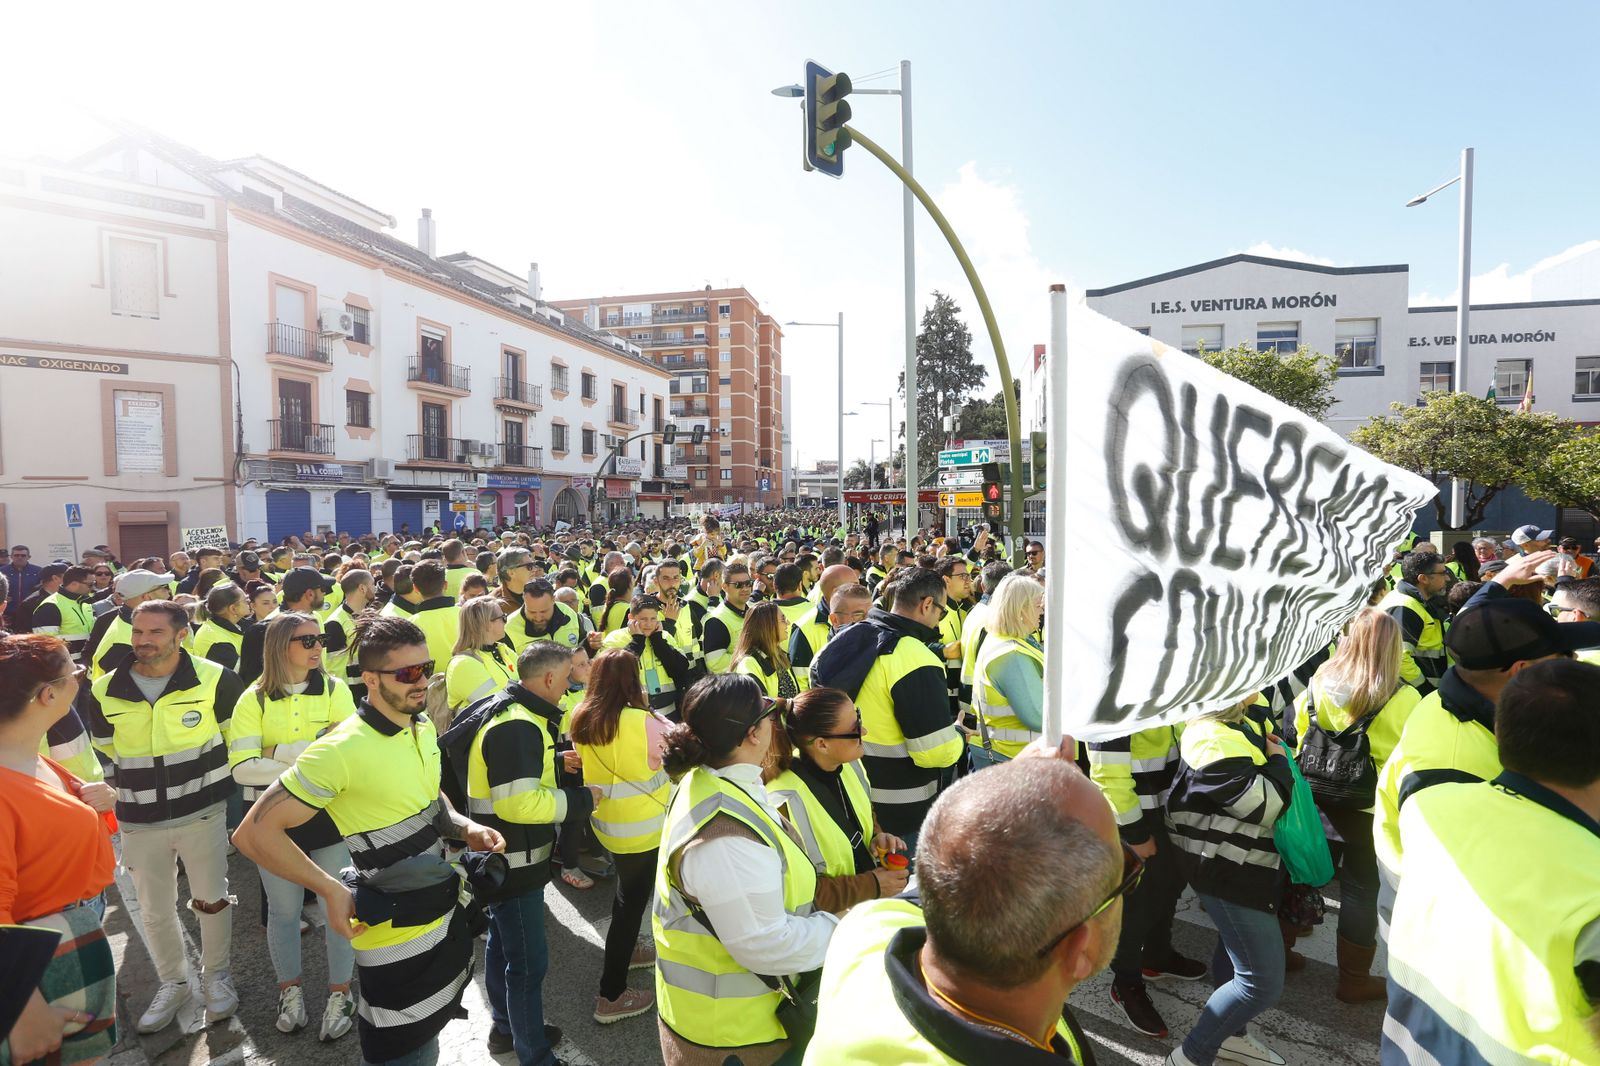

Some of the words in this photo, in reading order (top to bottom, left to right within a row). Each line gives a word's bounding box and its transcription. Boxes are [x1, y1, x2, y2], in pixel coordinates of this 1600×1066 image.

[1151, 301, 1186, 314] I.E.S.
[1191, 297, 1267, 312] VENTURA
[1272, 291, 1337, 309] MORÓN
[1434, 333, 1498, 346] VENURA
[1501, 329, 1556, 344] MORÓN
[39, 358, 121, 373] OXIGENADO
[186, 528, 223, 536] ACERINOX
[189, 533, 220, 541] ESCUCHA
